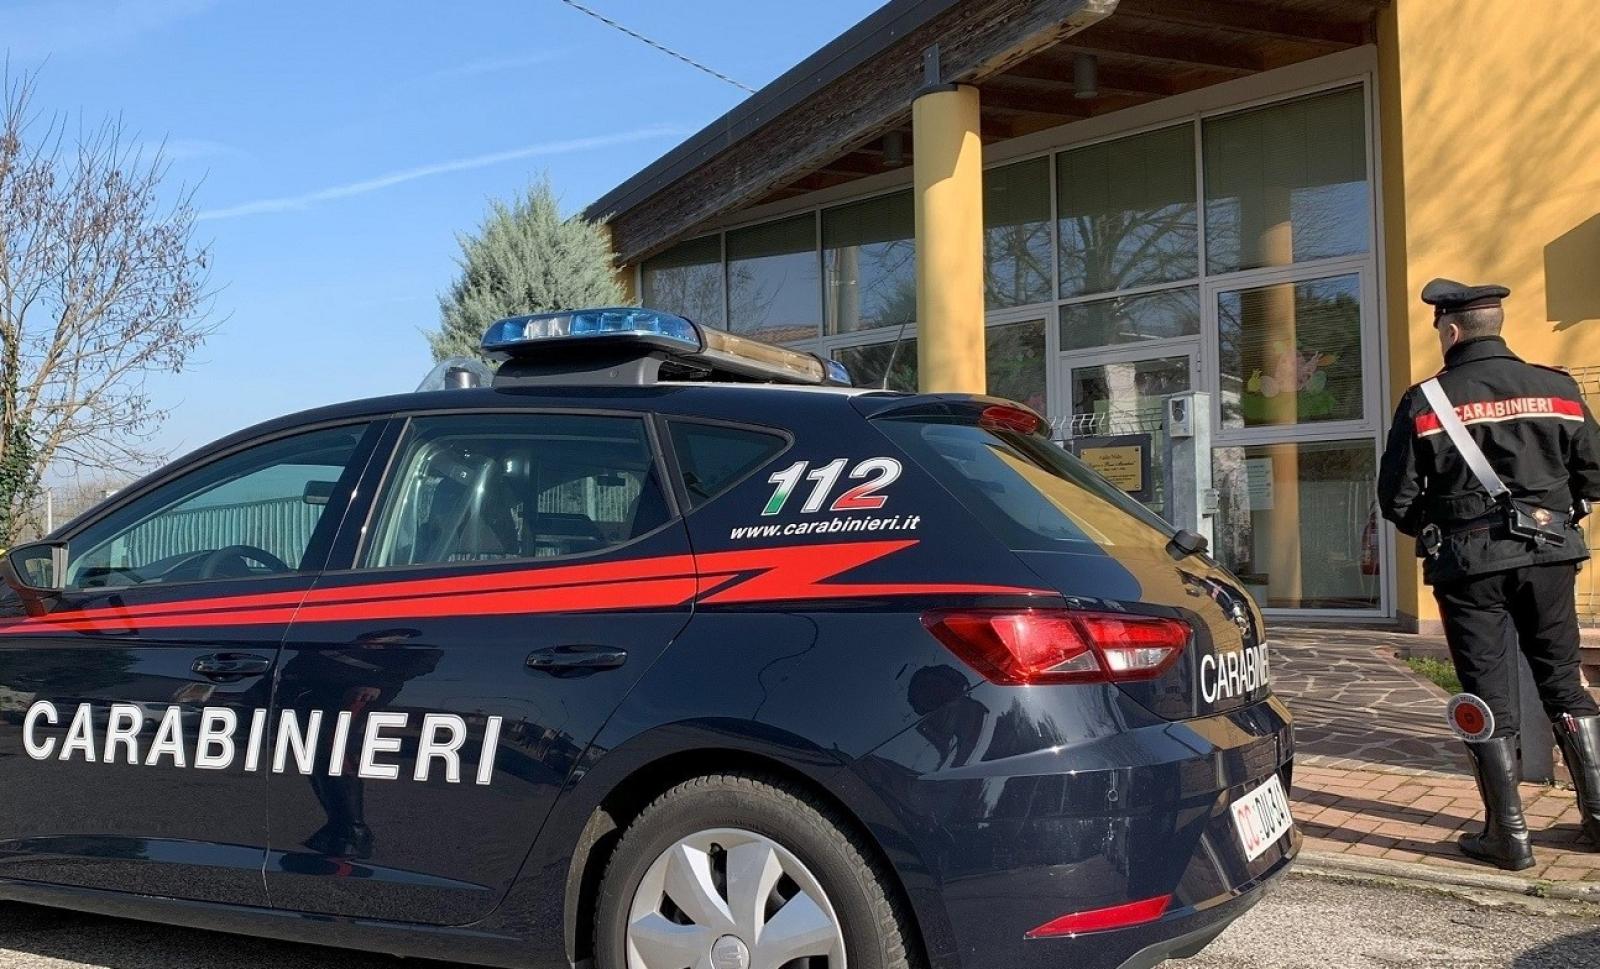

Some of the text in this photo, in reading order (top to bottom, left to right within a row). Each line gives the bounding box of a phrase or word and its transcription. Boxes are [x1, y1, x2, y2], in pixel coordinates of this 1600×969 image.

[760, 456, 902, 516] 112
[730, 514, 921, 540] www.carabinieri.it
[22, 700, 503, 785] CARABINIERI
